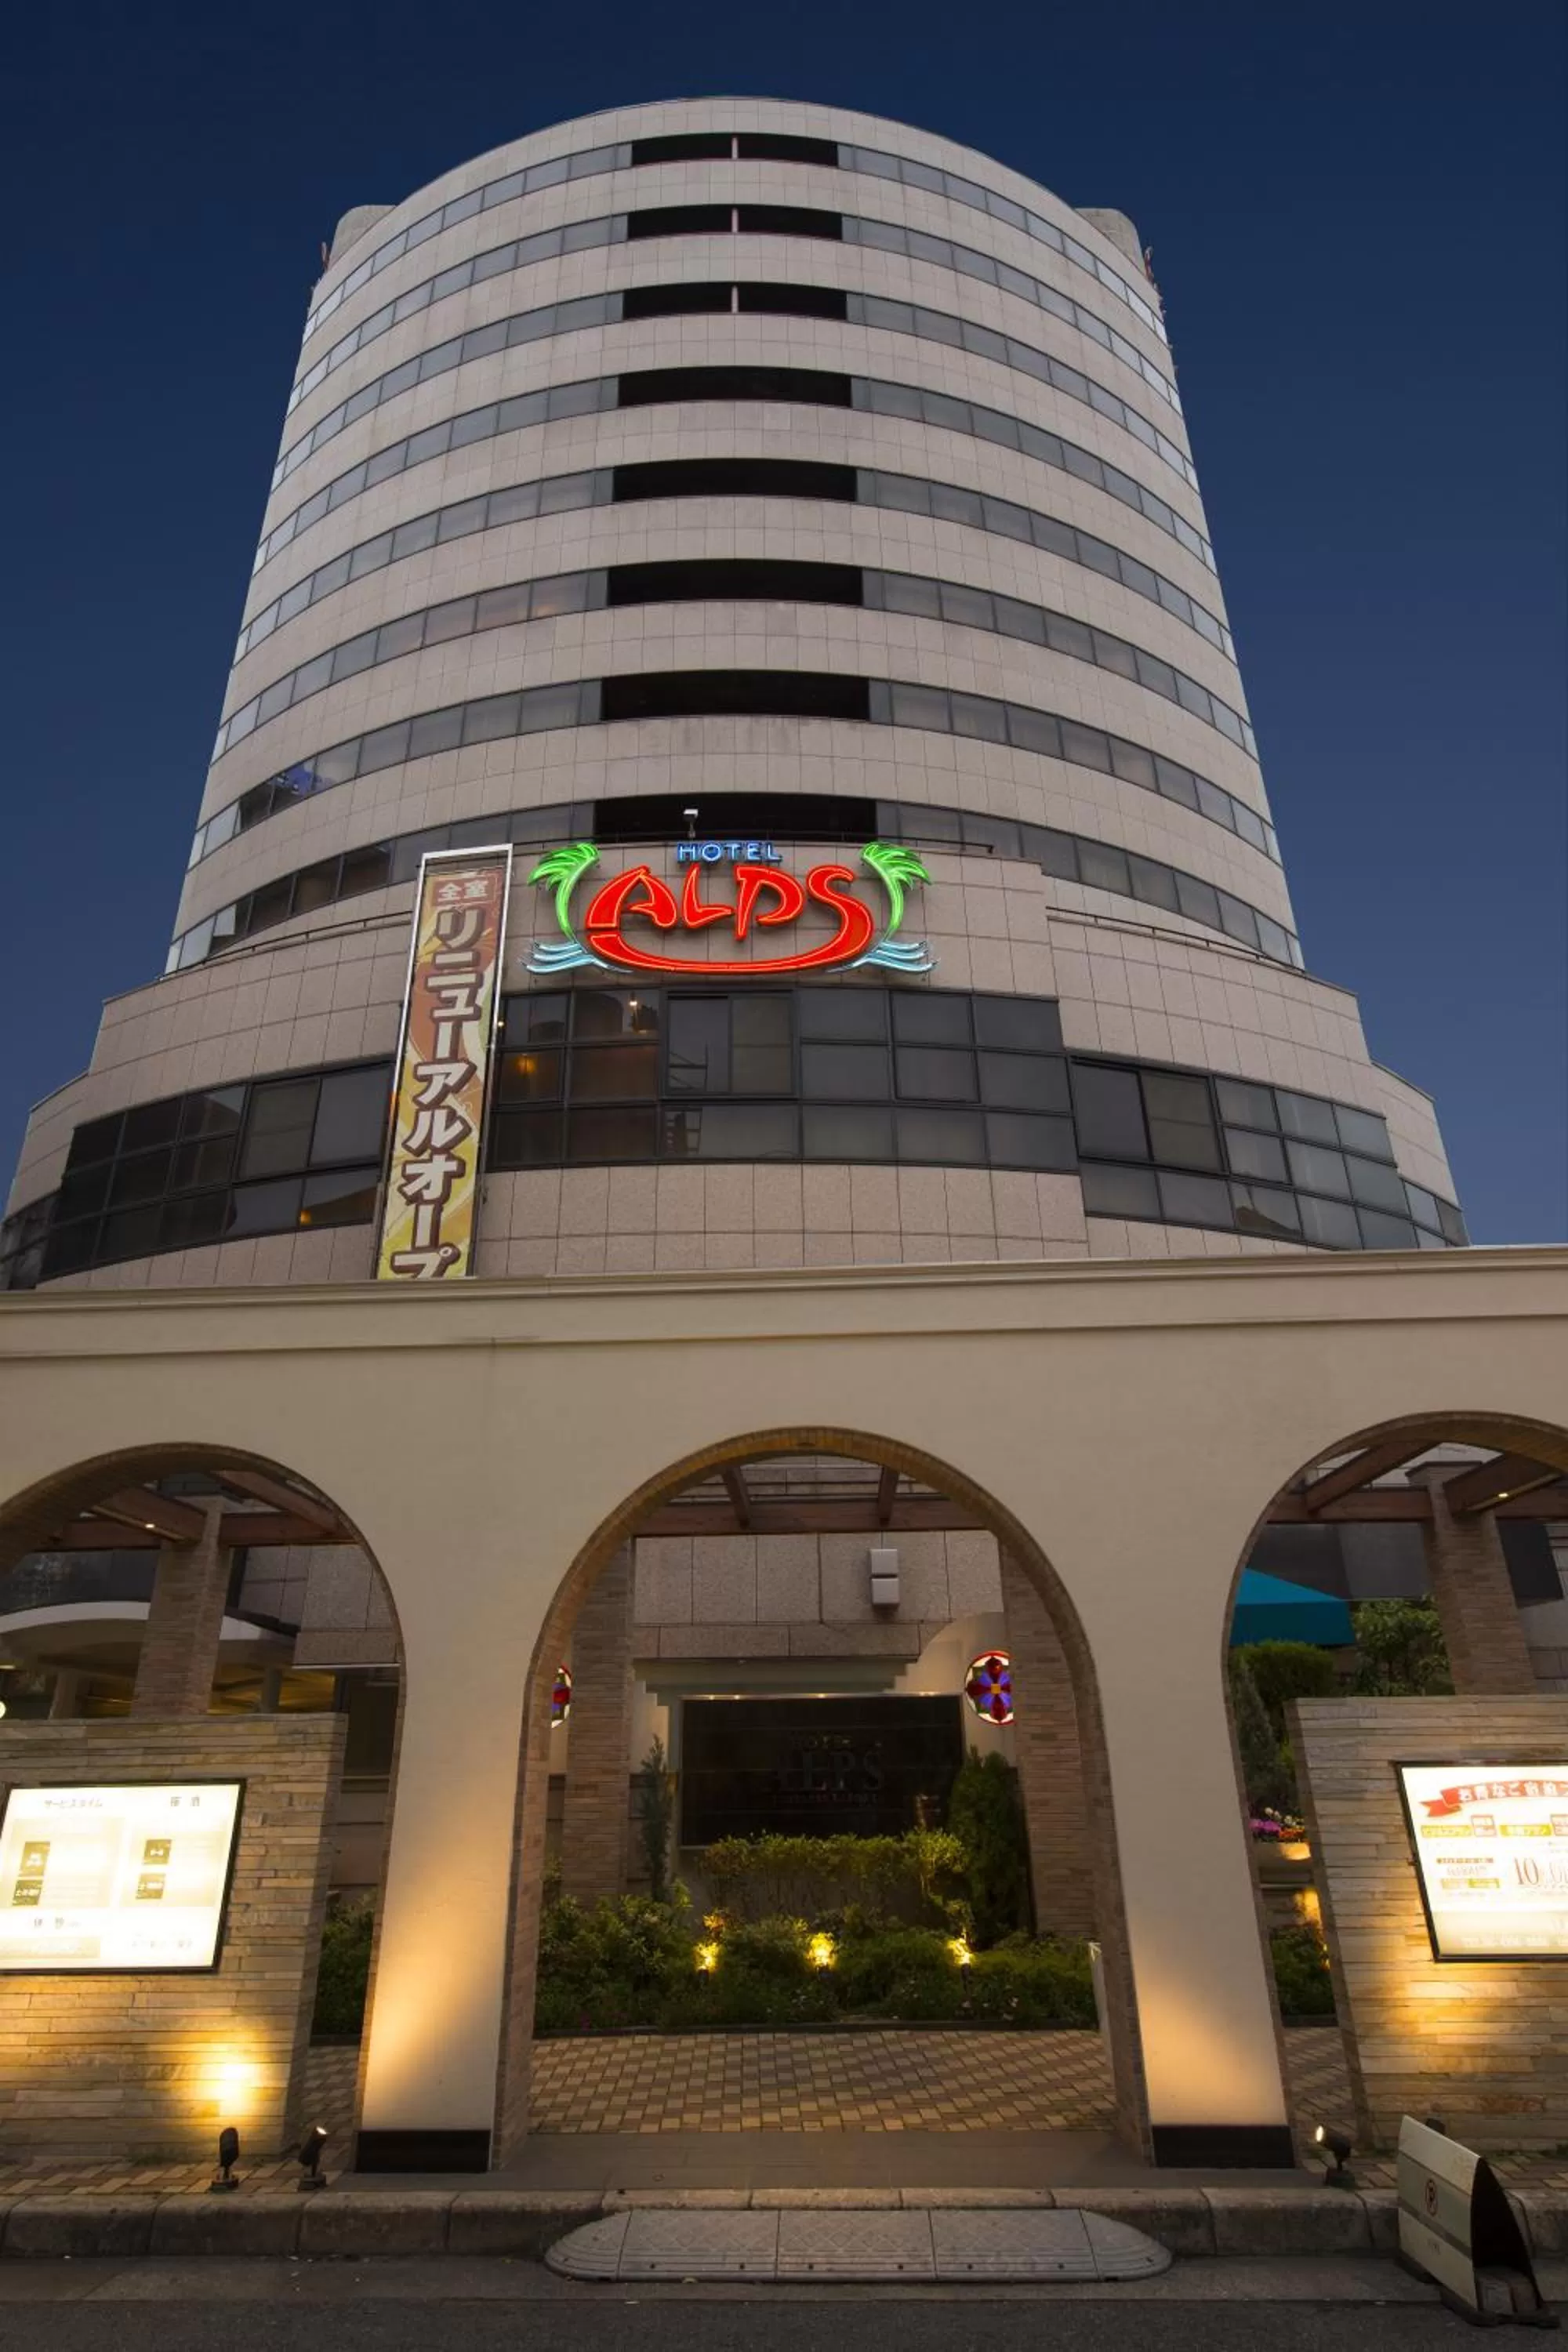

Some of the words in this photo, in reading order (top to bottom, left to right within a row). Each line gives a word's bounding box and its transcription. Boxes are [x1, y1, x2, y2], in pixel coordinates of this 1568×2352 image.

[678, 843, 782, 862] HOTEL
[437, 880, 488, 902] 全室
[586, 866, 875, 975] ALPS
